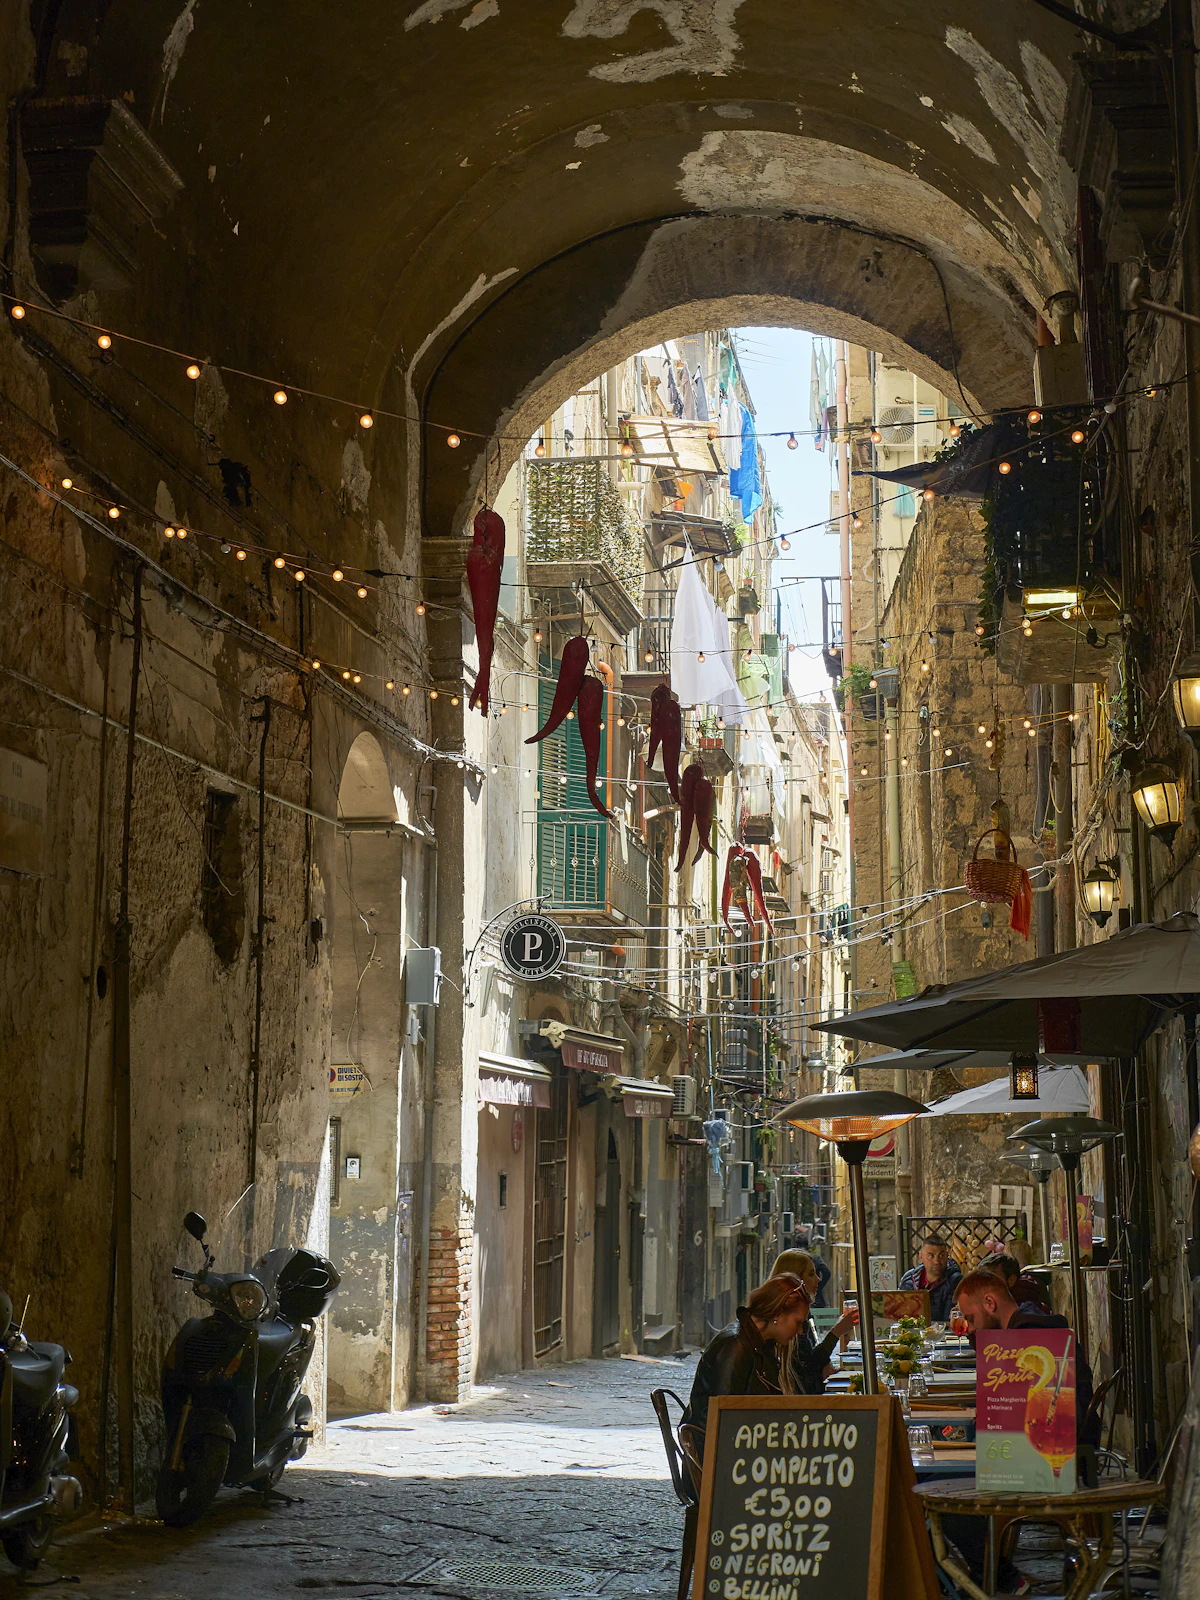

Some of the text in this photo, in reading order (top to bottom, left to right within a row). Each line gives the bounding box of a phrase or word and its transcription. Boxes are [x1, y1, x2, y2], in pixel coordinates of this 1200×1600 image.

[510, 919, 557, 937] PULCINELLA
[519, 967, 545, 976] SUITE
[983, 1344, 1025, 1363] Pizza
[983, 1367, 1035, 1392] Spritz
[1000, 1396, 1026, 1404] Margherita
[986, 1439, 1012, 1460] 6€
[732, 1453, 855, 1488] COMPLETO
[744, 1487, 832, 1519] €5,00
